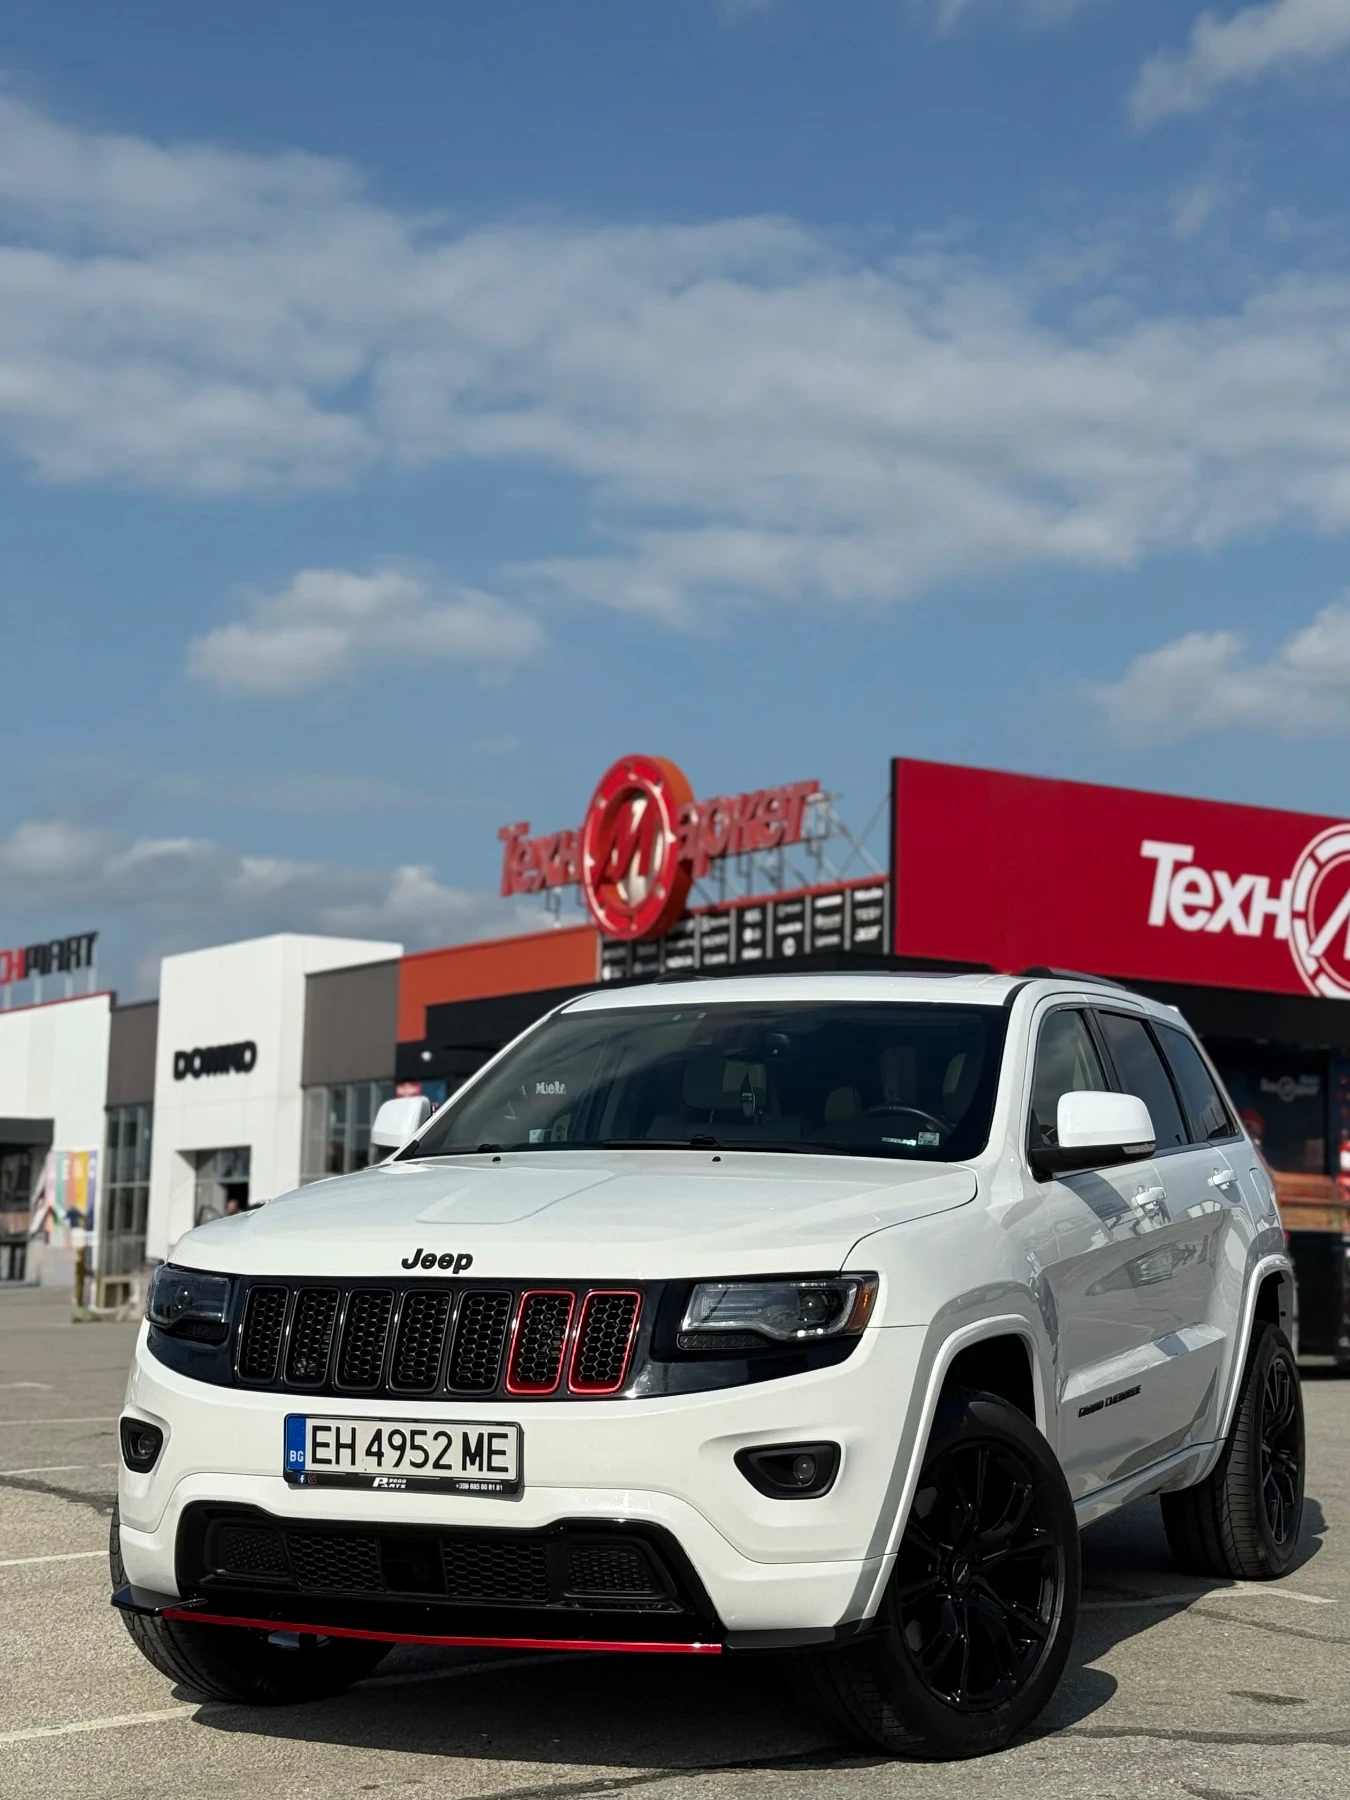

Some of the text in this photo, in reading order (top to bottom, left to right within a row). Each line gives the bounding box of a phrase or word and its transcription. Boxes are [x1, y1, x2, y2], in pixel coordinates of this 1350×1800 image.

[173, 1040, 257, 1081] DOMINO
[401, 1248, 473, 1275] Jeep
[289, 1450, 304, 1463] BG
[311, 1425, 509, 1473] EH 4952 ME
